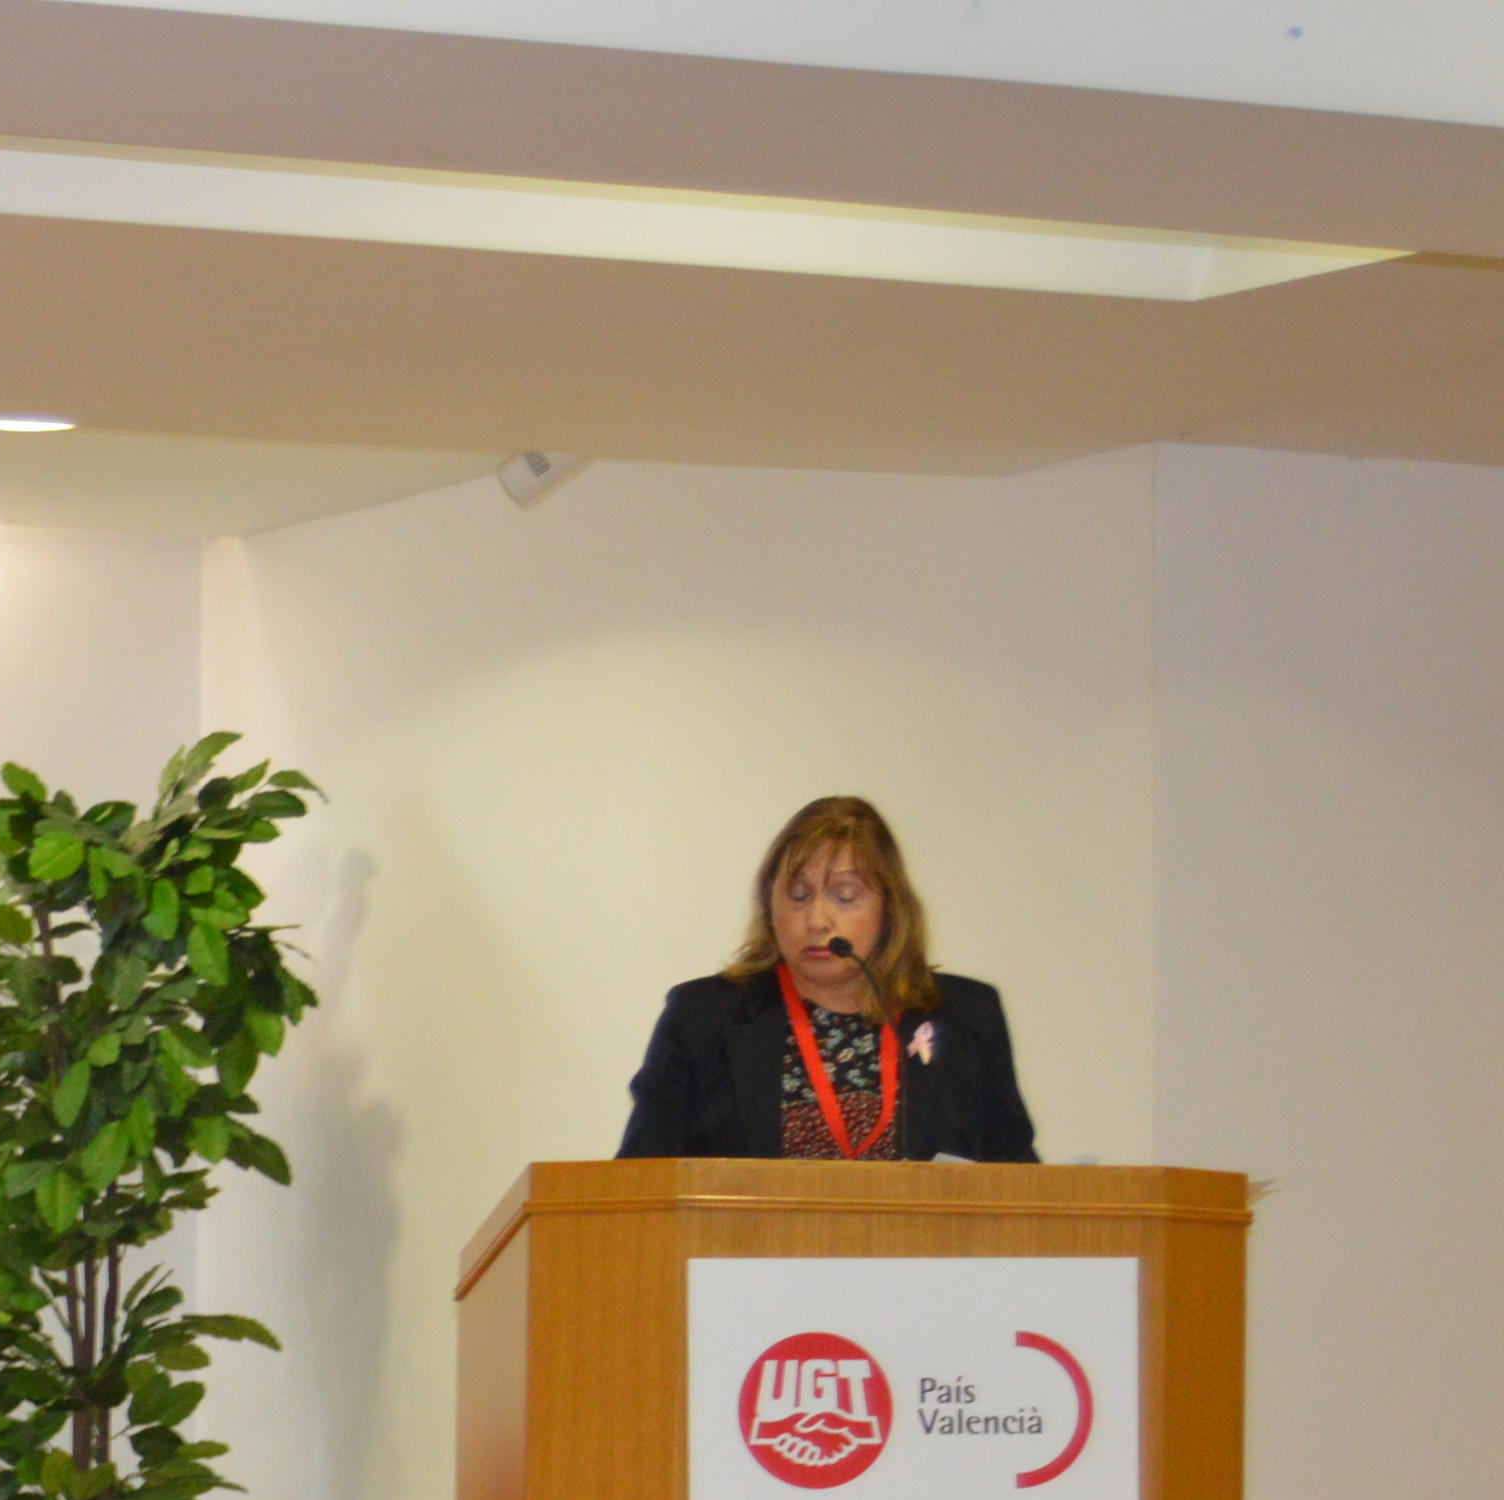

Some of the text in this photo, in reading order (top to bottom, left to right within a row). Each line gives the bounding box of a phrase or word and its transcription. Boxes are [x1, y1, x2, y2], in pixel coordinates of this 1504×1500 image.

[756, 1358, 872, 1420] UGT
[918, 1376, 976, 1404] País
[918, 1407, 1043, 1435] Valencià
